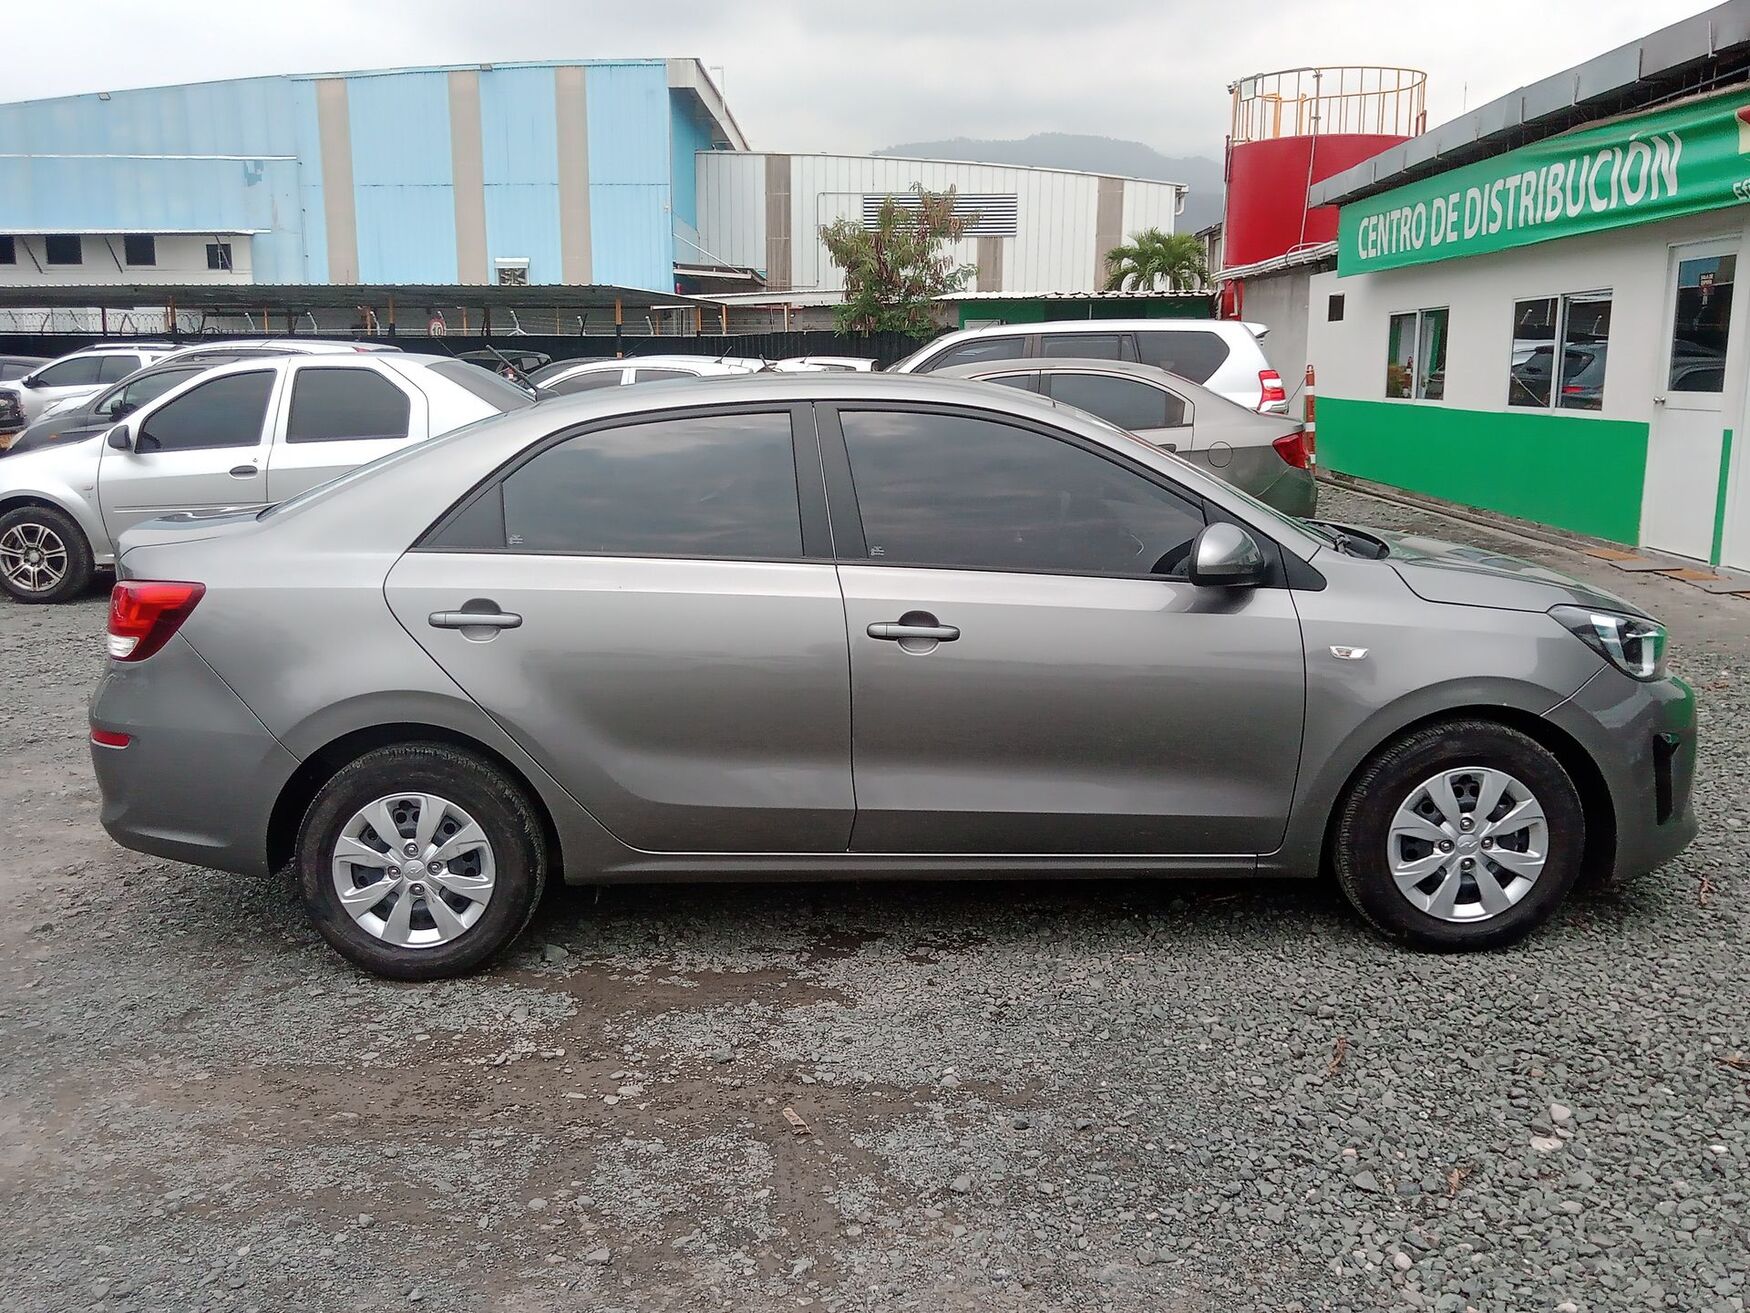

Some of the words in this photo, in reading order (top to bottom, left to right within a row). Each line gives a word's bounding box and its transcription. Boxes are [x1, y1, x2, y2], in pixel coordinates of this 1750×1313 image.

[1358, 203, 1425, 259] CENTRO
[1431, 191, 1461, 246] DE
[1464, 132, 1683, 239] DISTRIBUCIÓN
